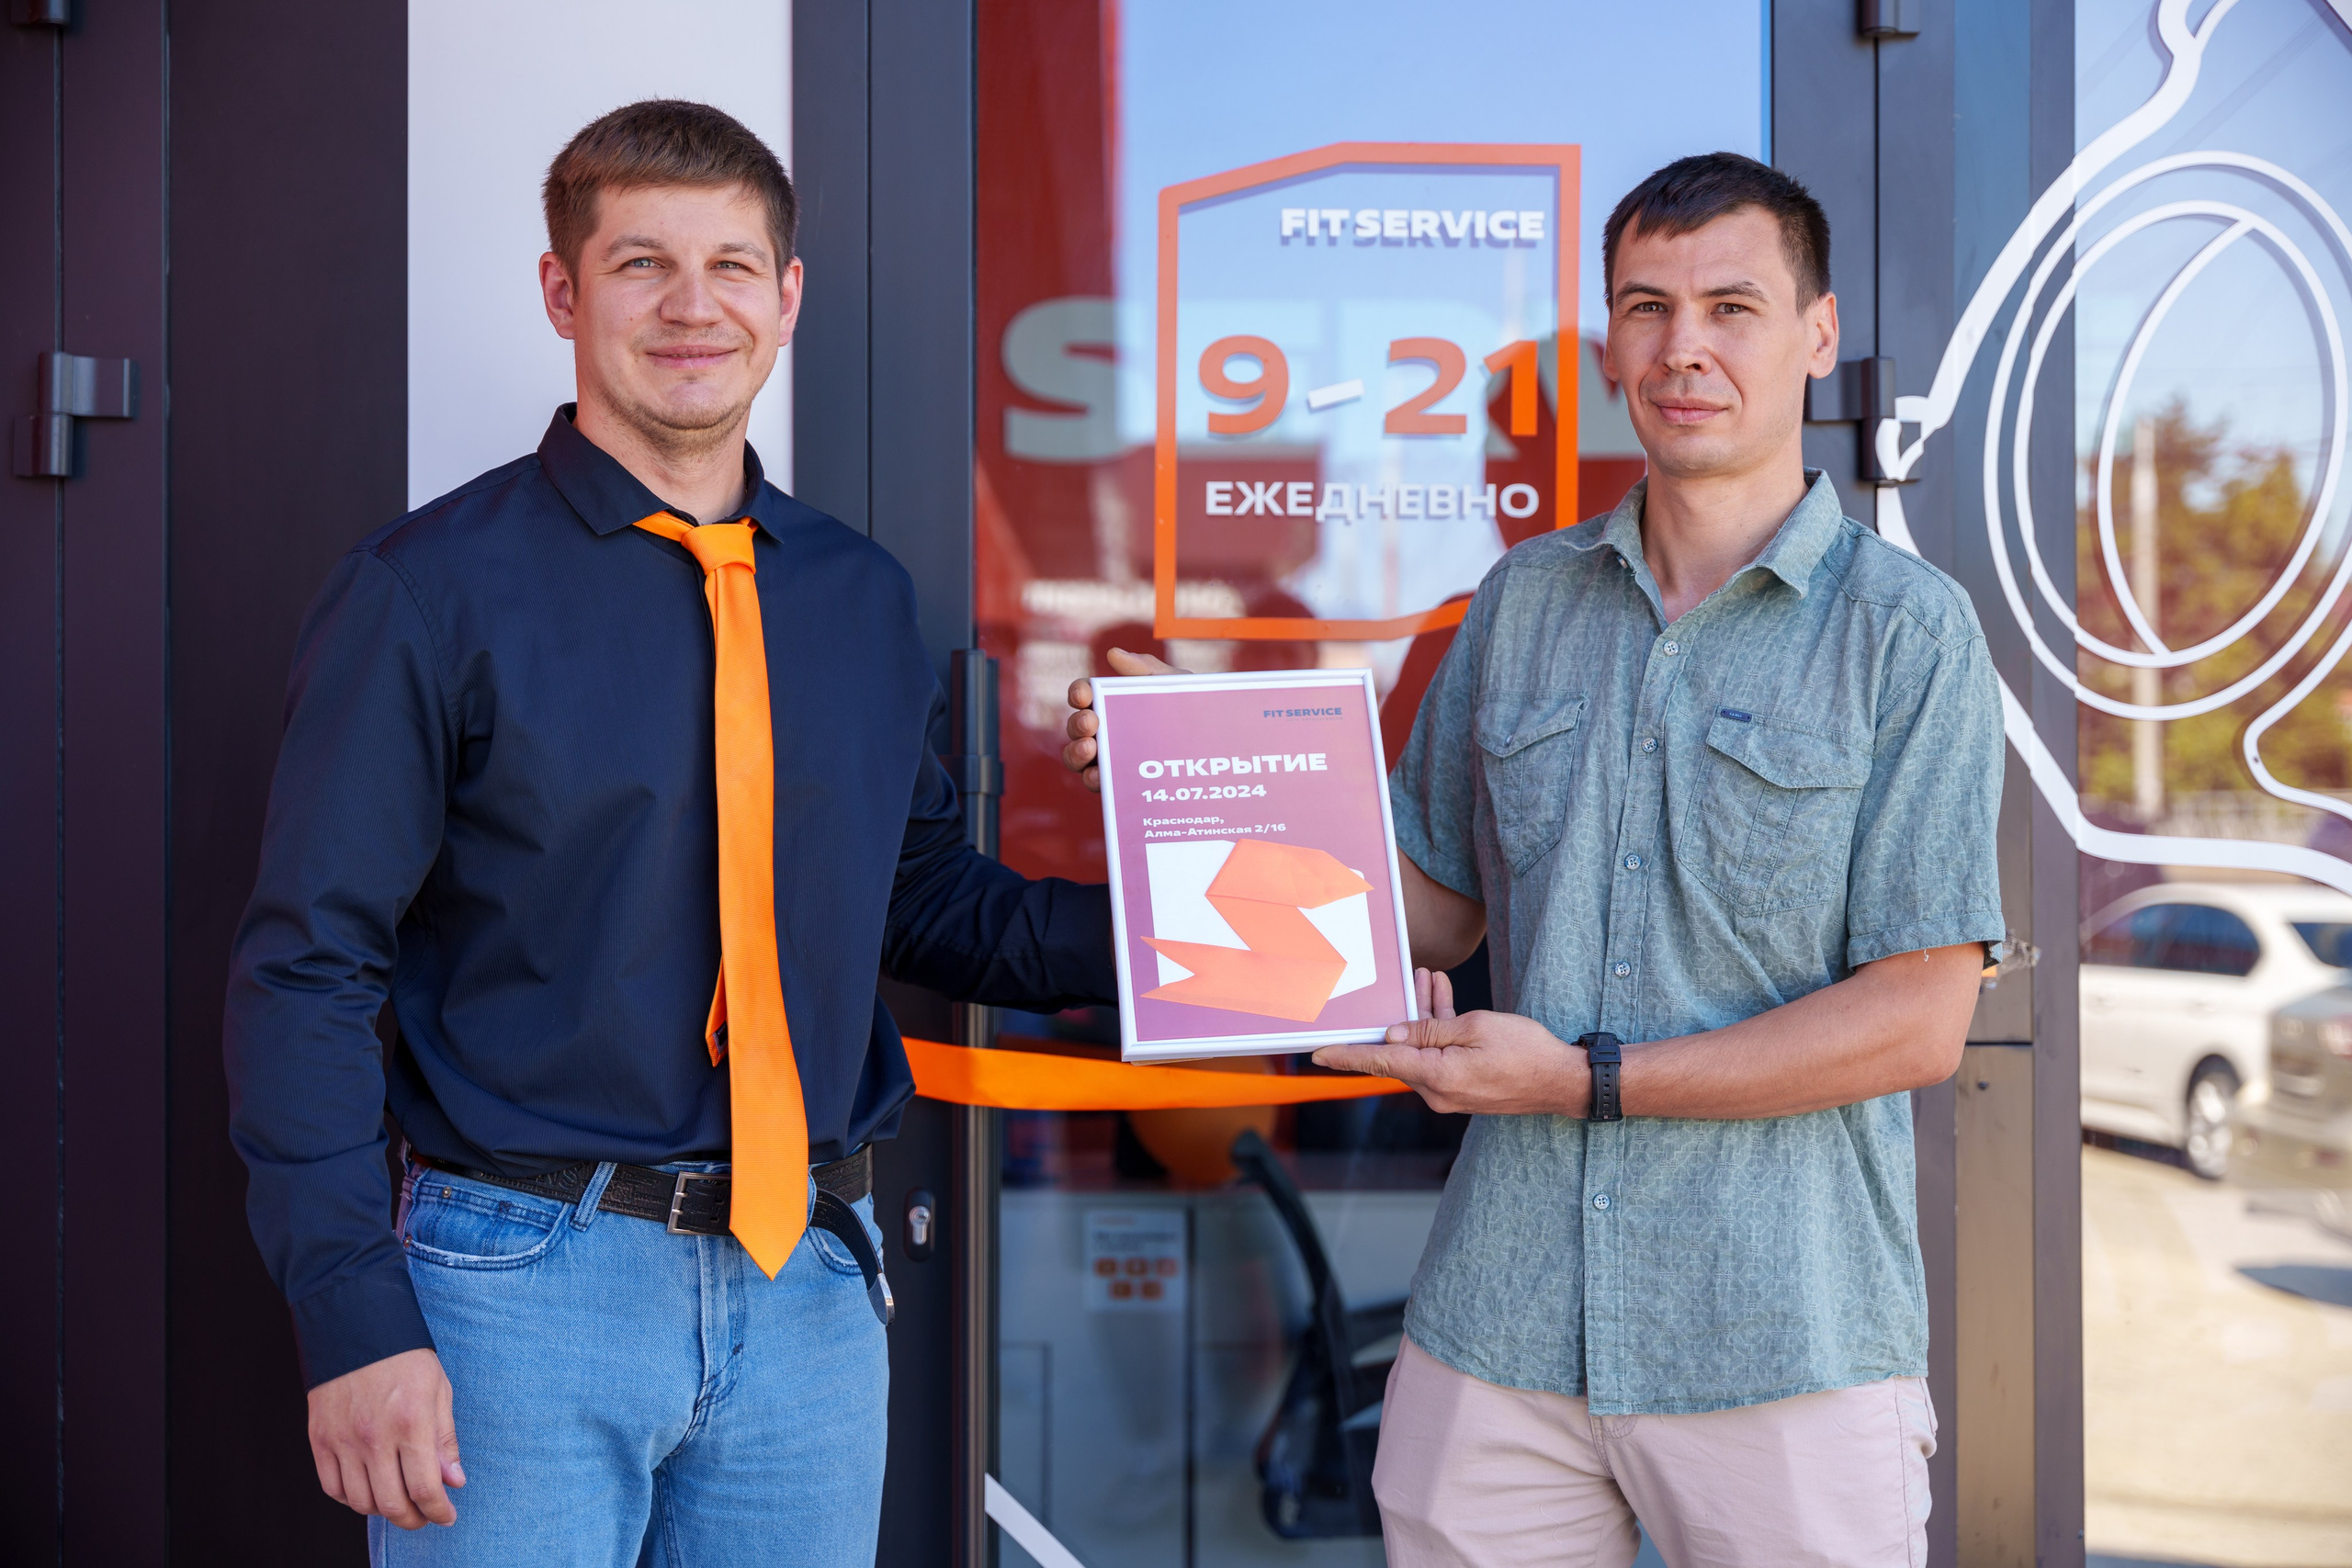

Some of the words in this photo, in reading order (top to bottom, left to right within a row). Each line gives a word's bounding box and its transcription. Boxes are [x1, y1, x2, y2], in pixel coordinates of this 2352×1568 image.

[1281, 208, 1350, 237] FIT
[1354, 209, 1544, 240] SERVICE
[1198, 333, 1290, 435] 9
[1384, 336, 1539, 436] 21
[1205, 480, 1539, 523] ЕЖЕДНЕВНО
[1263, 709, 1284, 717] FIT
[1285, 707, 1342, 716] SERVICE
[1138, 752, 1328, 779] ОТКРЫТИЕ
[1141, 784, 1267, 803] 14.07.2024
[1143, 815, 1225, 828] Краснодар,
[1144, 826, 1252, 839] Алма-Атинская
[1254, 823, 1286, 834] 2/16
